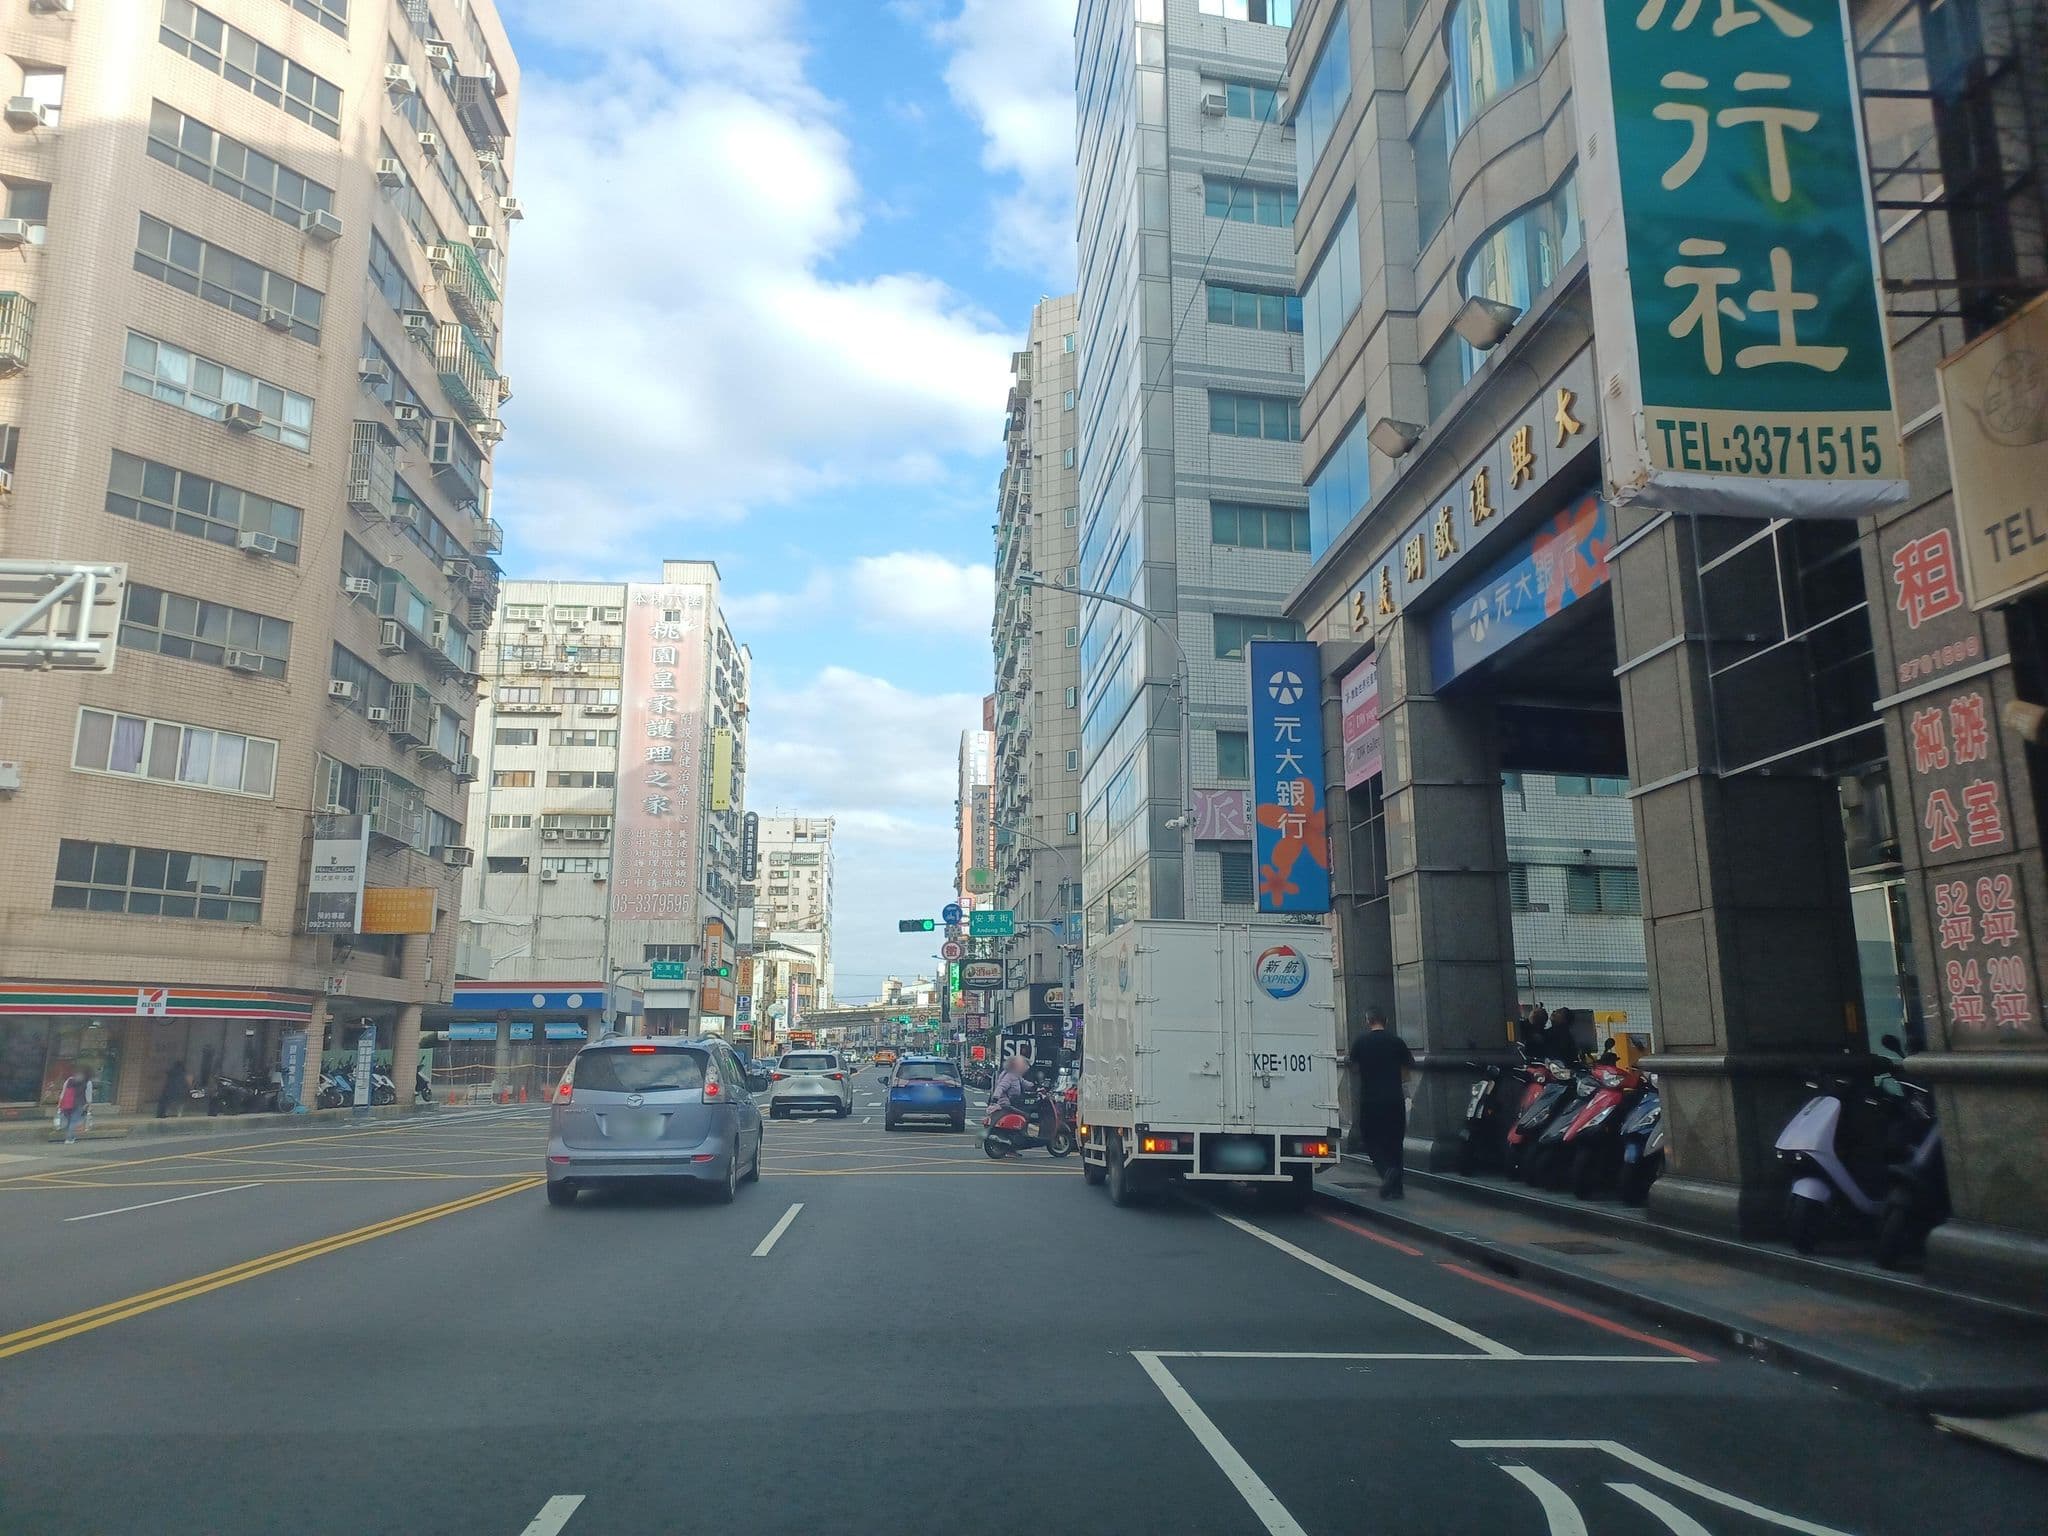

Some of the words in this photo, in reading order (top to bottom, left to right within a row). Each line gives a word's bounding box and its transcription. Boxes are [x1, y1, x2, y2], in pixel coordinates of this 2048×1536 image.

[1636, 0, 1850, 376] 行社
[1656, 418, 1882, 475] TEL:3371515
[1494, 533, 1580, 624] 元大銀行
[1893, 527, 1964, 630] 租
[643, 620, 682, 816] 桃園皇家護理之家
[1273, 716, 1308, 840] 元大銀行
[613, 893, 690, 913] 03-3379595
[1935, 880, 1970, 917] 52
[1976, 874, 2015, 912] 62
[975, 914, 1008, 924] 安東街
[1939, 916, 1975, 950] 坪
[1980, 911, 2018, 947] 坪
[1261, 974, 1302, 985] EXPRESS
[1264, 960, 1300, 974] 新航
[1947, 958, 1982, 994] 84
[1987, 955, 2027, 993] 200
[1253, 1053, 1313, 1072] KPE-1081
